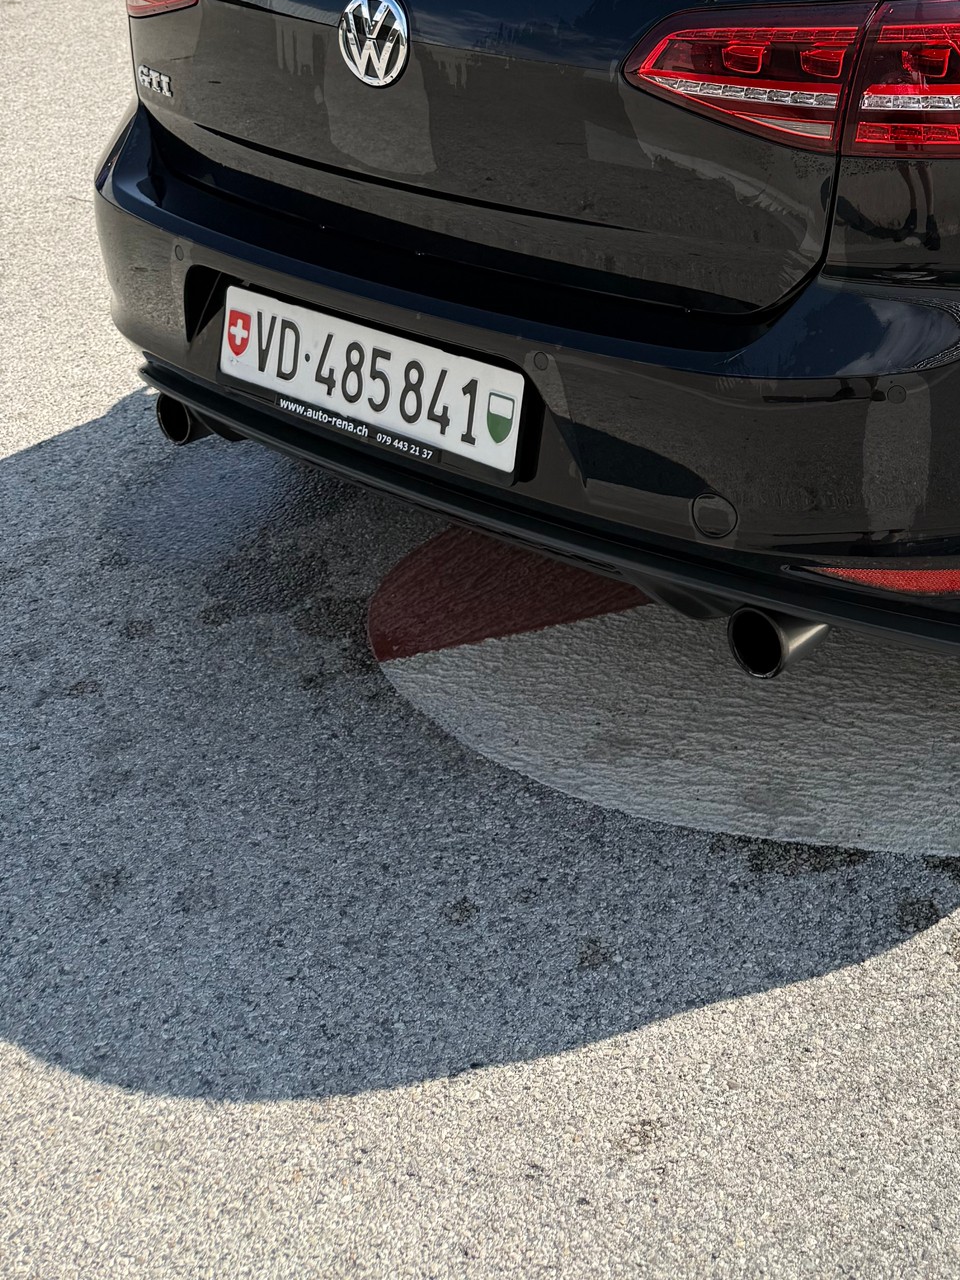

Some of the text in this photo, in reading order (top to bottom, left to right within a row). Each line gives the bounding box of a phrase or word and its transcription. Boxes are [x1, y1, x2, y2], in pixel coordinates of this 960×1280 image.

[138, 65, 172, 97] GTI
[279, 398, 433, 460] www.auto-rena.ch 079 443 21 37
